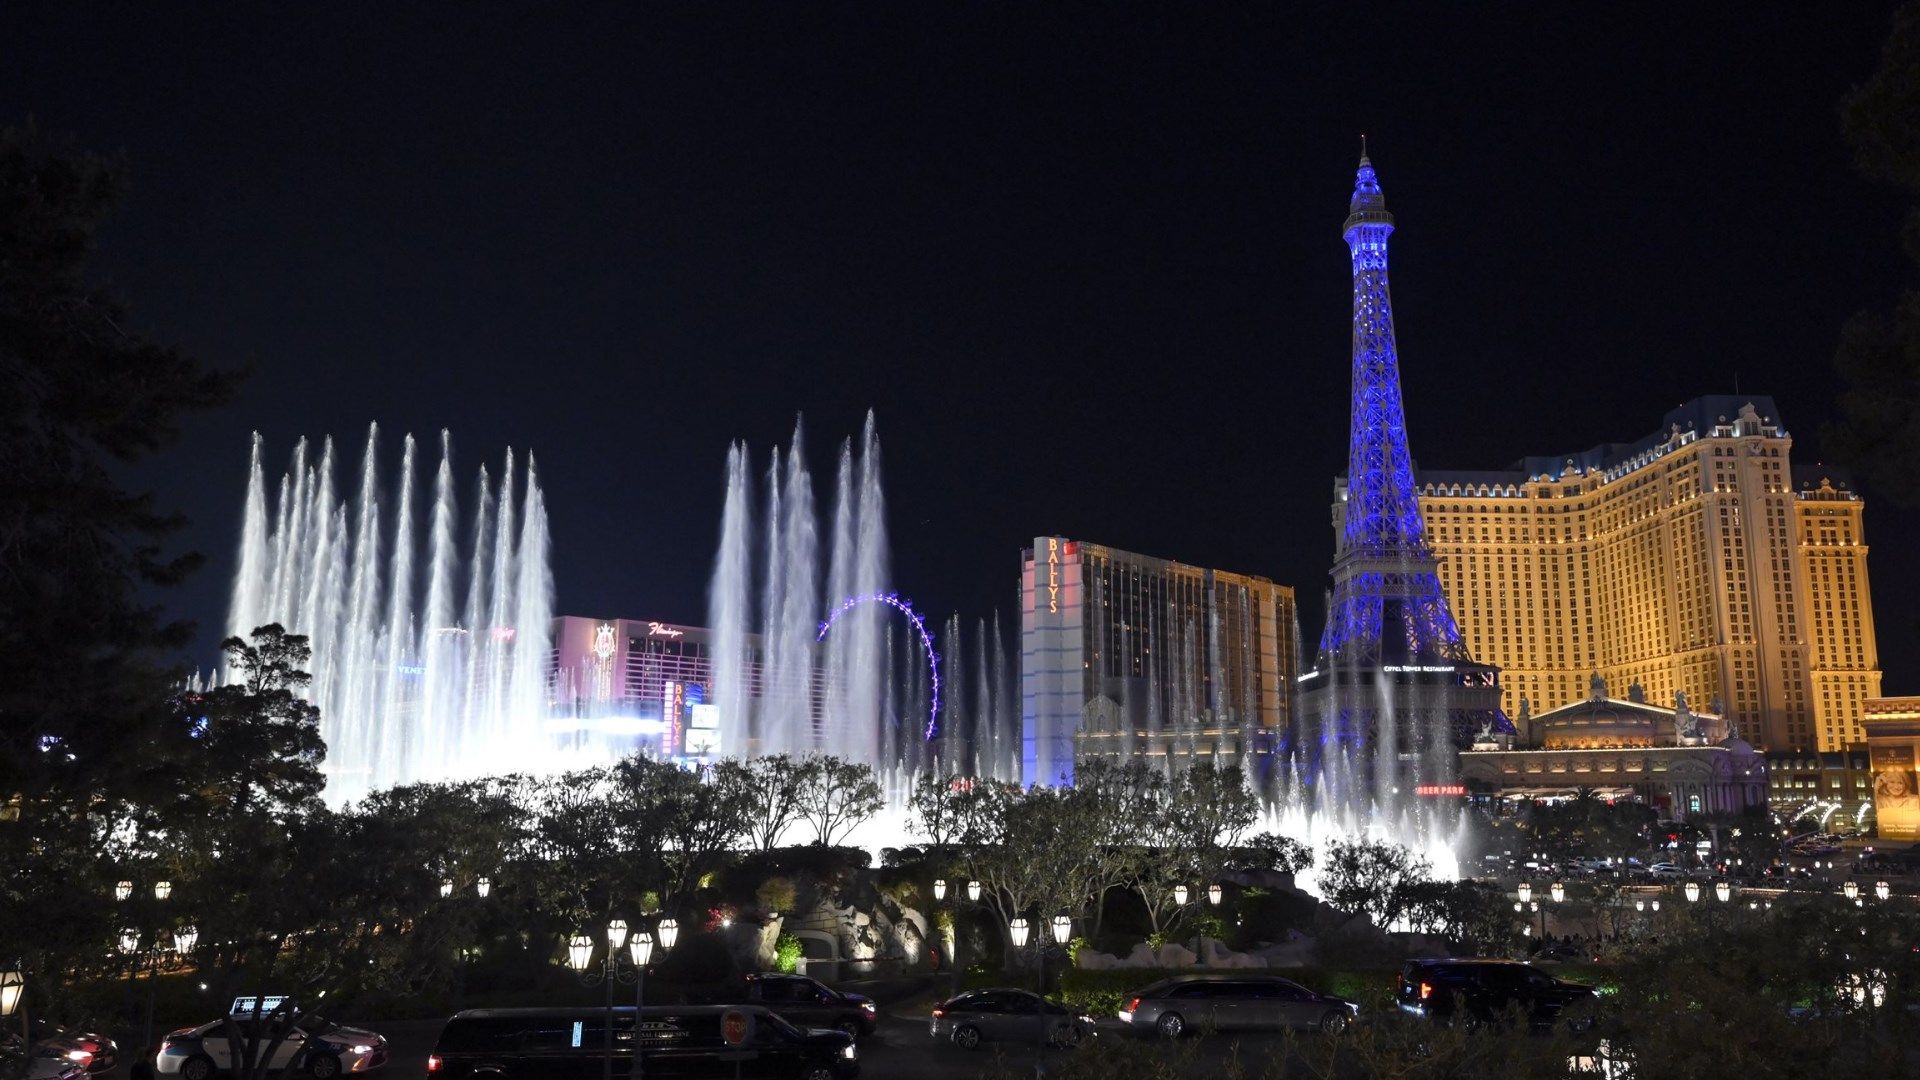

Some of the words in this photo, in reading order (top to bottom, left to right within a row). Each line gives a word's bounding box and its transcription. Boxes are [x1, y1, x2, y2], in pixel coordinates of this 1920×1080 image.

[648, 621, 684, 639] Flamingo
[1416, 786, 1439, 795] BEER
[1441, 786, 1464, 795] PARK
[726, 1020, 746, 1033] STOP
